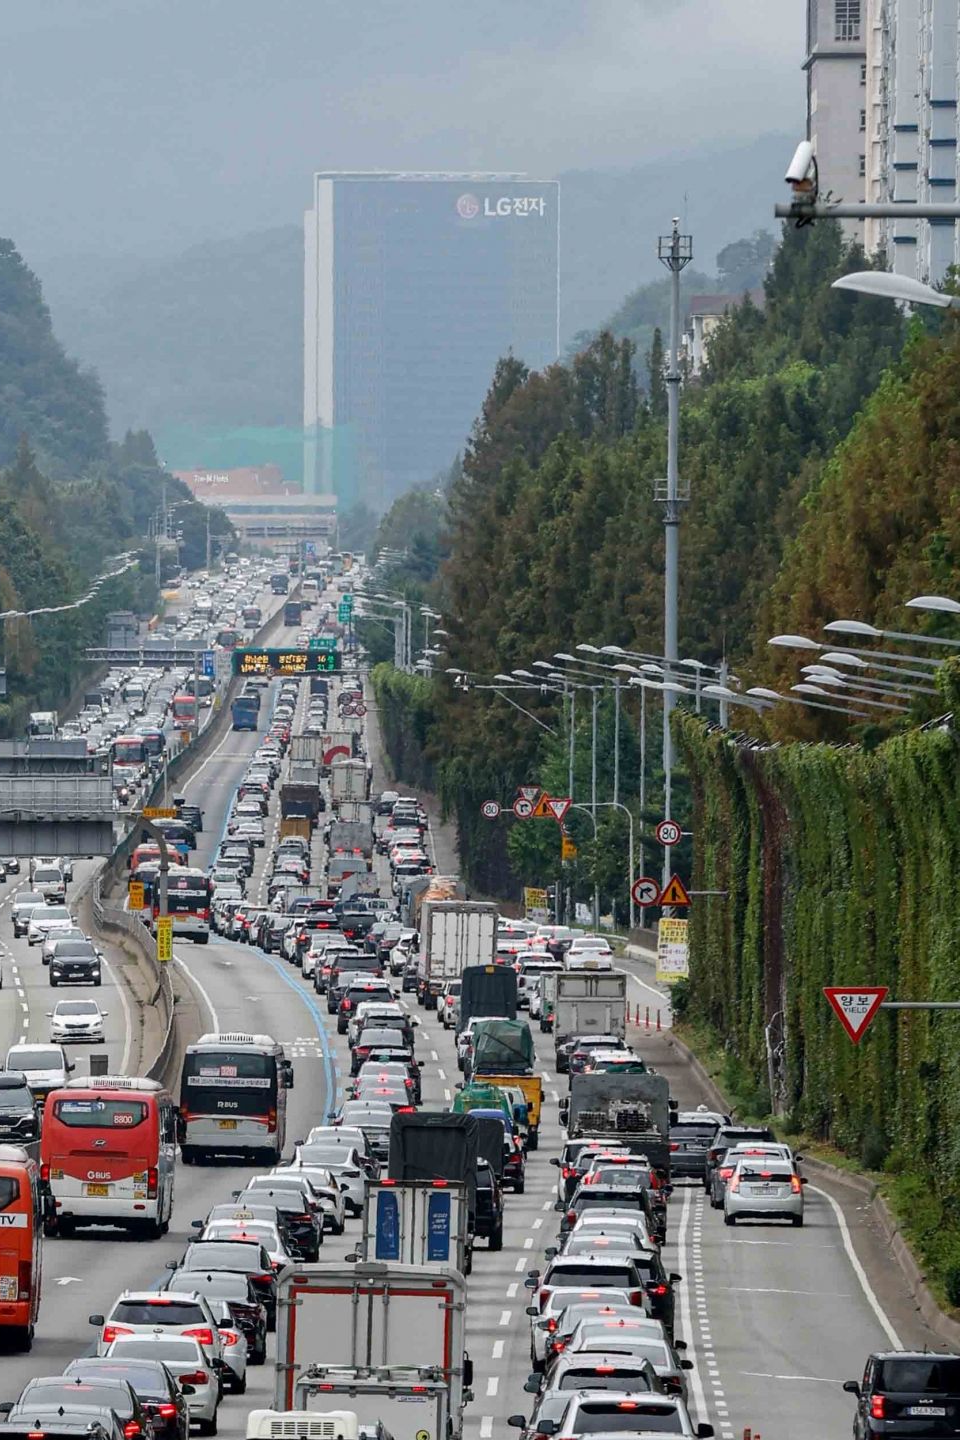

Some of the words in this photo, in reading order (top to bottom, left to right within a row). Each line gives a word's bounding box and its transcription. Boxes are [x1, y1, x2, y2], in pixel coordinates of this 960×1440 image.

[484, 197, 546, 216] LG전자
[662, 828, 676, 840] 80
[841, 996, 870, 1006] 양보
